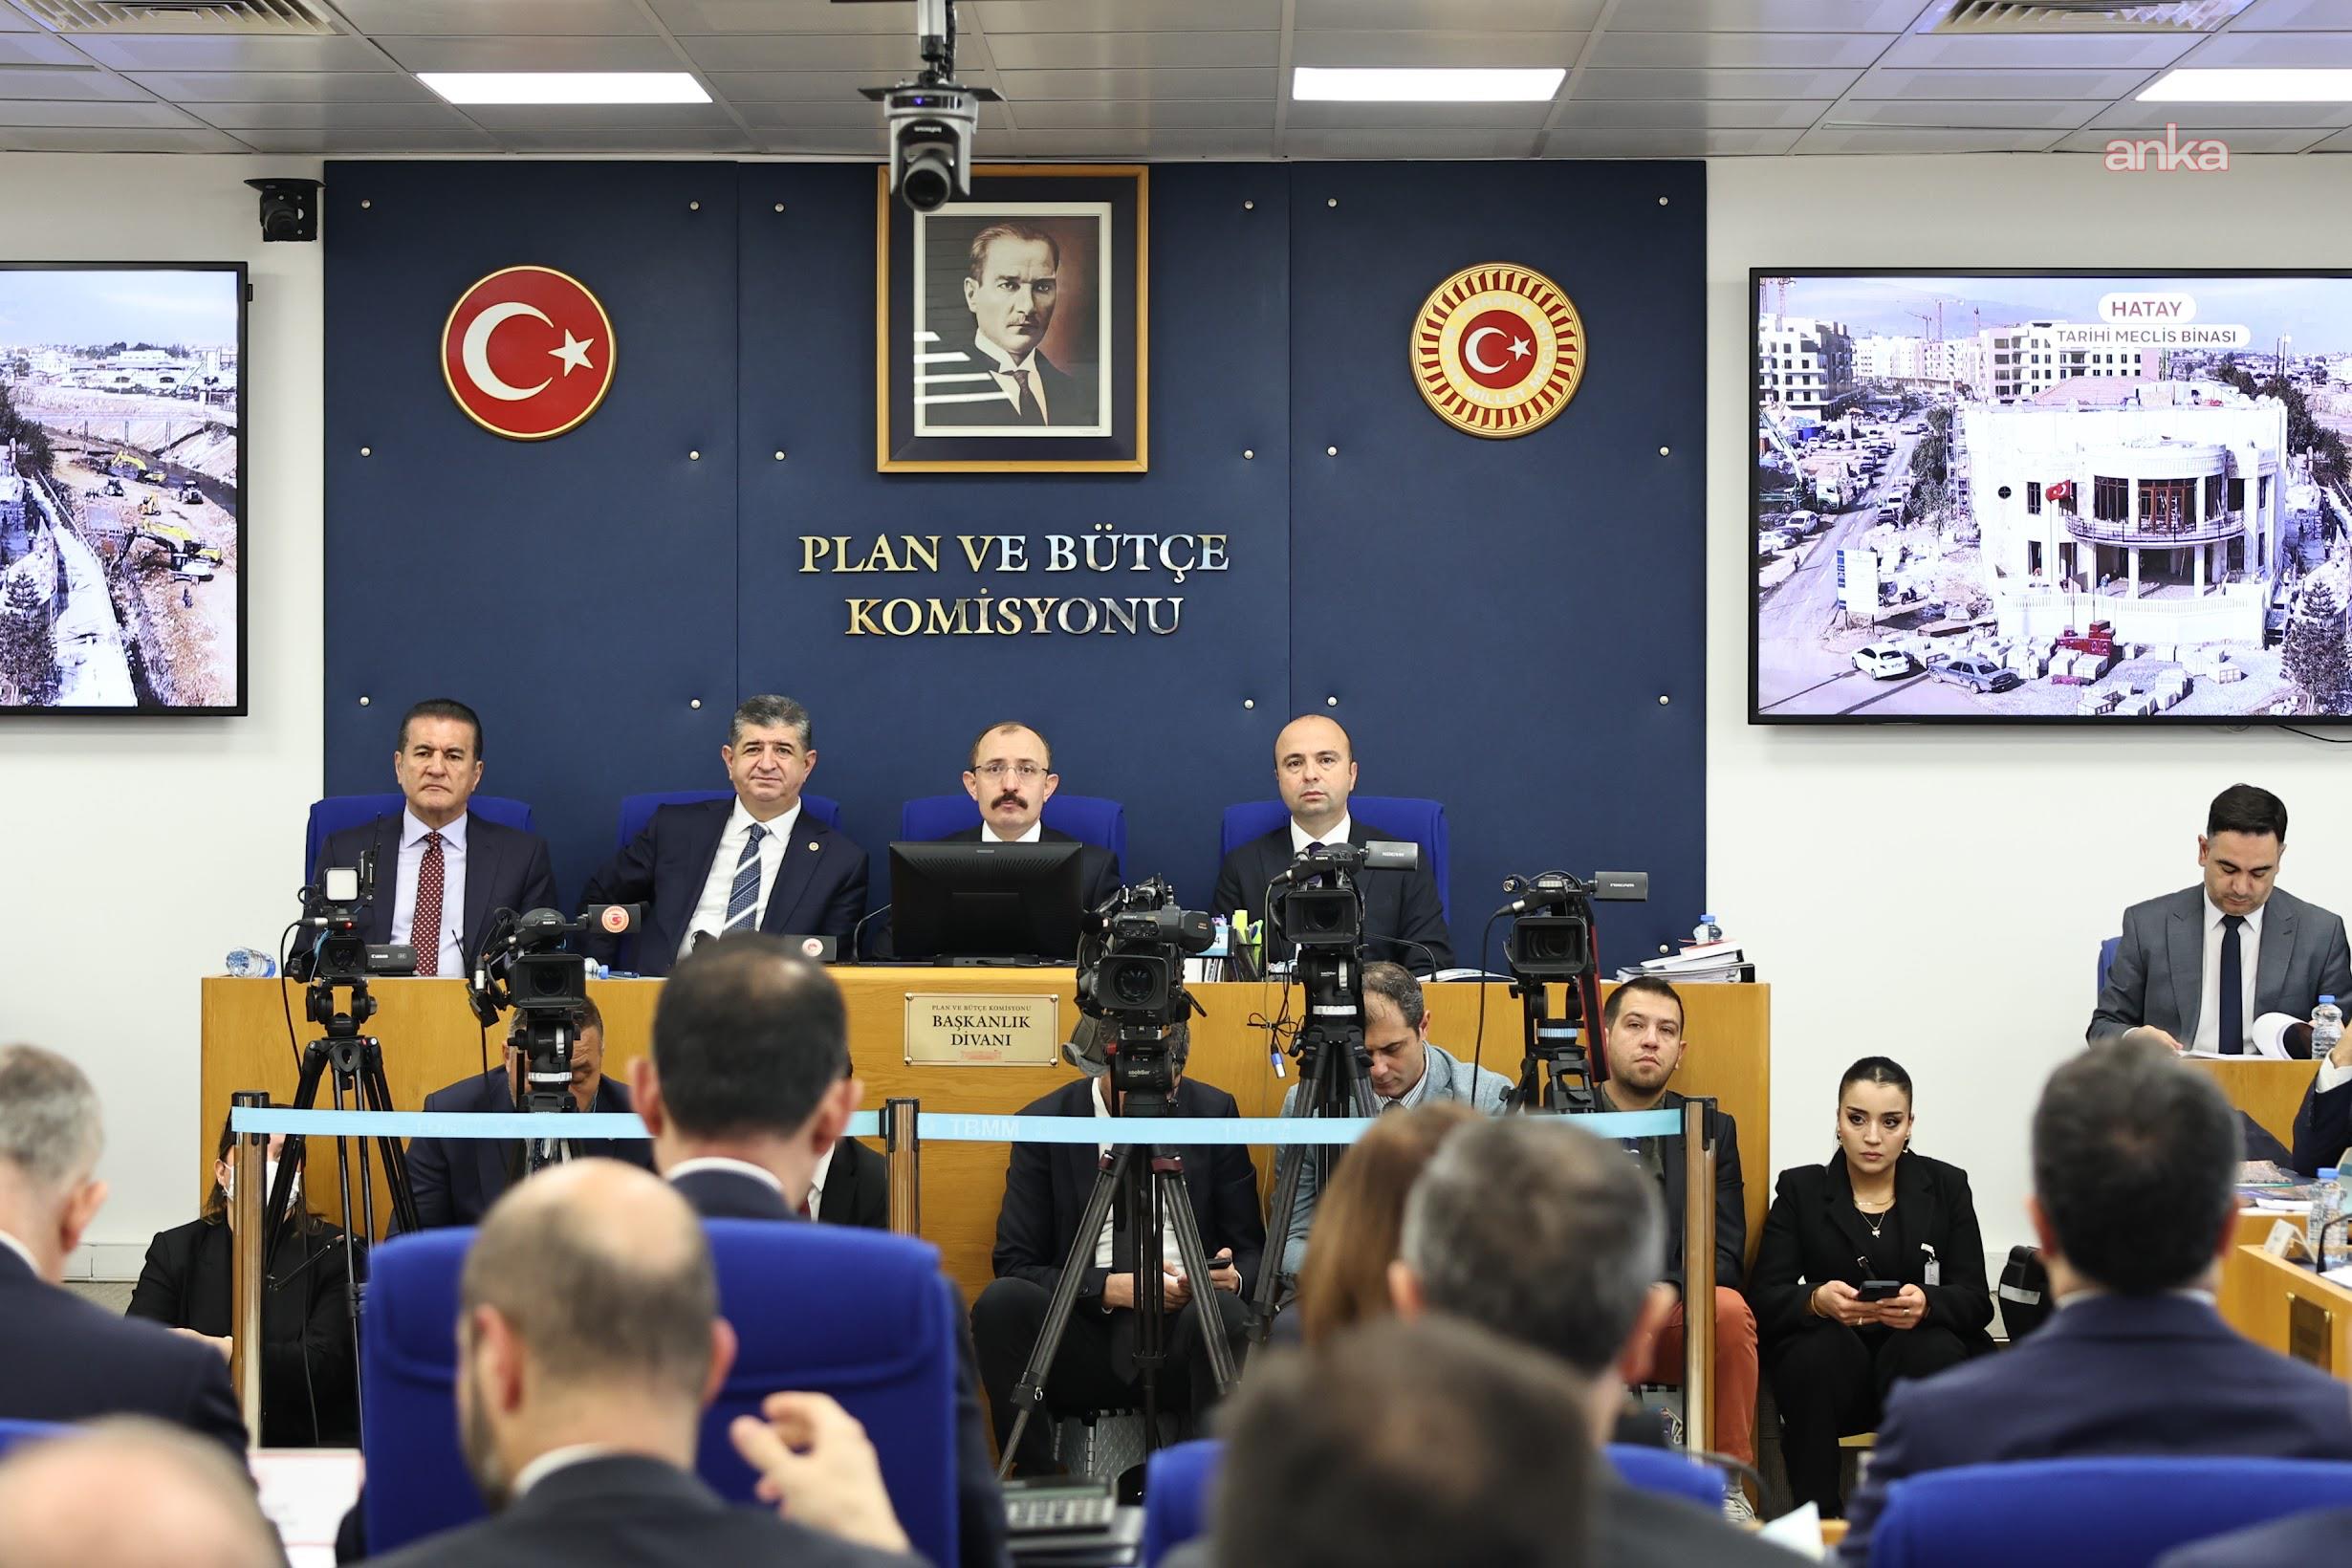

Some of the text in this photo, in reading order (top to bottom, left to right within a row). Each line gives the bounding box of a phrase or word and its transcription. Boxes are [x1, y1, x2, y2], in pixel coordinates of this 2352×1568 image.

[2111, 301, 2182, 316] HATAY
[2058, 327, 2236, 342] TARİHİ MECLİS BİNASI
[797, 523, 1230, 583] PLAN VE BÜTÇE
[844, 587, 1184, 636] KOMİSYONU
[964, 1004, 988, 1013] BÜTÇE
[932, 1014, 1032, 1031] BAŞKANLIK
[950, 1031, 1013, 1047] DİVANI
[948, 1118, 1020, 1138] TBMM
